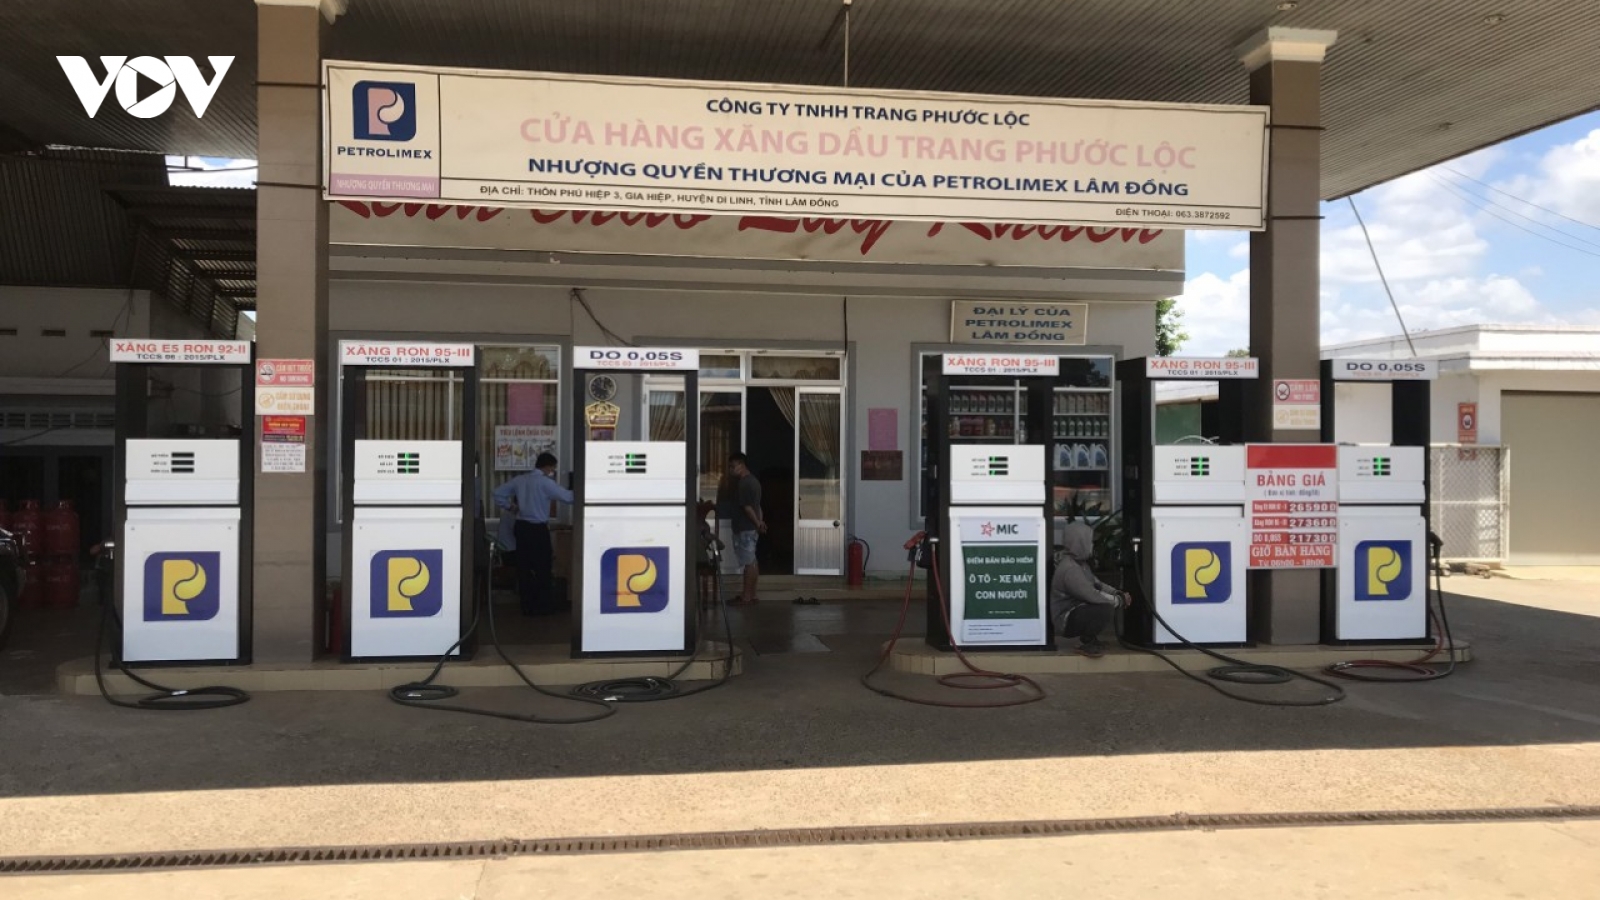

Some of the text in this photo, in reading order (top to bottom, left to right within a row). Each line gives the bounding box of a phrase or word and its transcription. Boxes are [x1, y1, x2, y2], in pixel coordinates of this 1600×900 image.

[706, 97, 1031, 129] CÔNG TY TNHH TRANG PHƯỚC LỘC
[519, 111, 1197, 174] CỬA HÀNG XĂNG DẦU TRANG PHƯỚC LỘC
[337, 145, 433, 160] PETROLIMEX
[528, 158, 1189, 196] NHƯỢNG QUYỀN THƯƠNG MẠI CỦA PETROLIMEX LÂM ĐỒNG
[480, 185, 499, 196] ĐỊA
[502, 185, 524, 196] CHỈ:
[527, 186, 557, 197] THÔN
[560, 186, 583, 198] PHÚ
[585, 189, 611, 200] HIỆP
[625, 191, 645, 201] GIA
[677, 193, 714, 205] HUYỆN
[716, 195, 727, 205] DI
[730, 196, 756, 206] LINH,
[758, 195, 782, 206] TỈNH
[785, 196, 807, 207] LÂM
[809, 196, 839, 208] ĐỒNG
[1115, 207, 1231, 220] ĐIỆN THOẠI: 063.3872592
[973, 305, 1071, 317] ĐẠI LÝ CỦA
[965, 319, 1073, 329] PETROLIMEX
[972, 329, 1065, 341] LÂM ĐỒNG
[115, 341, 246, 354] XĂNG E5 RON 92-II
[345, 344, 471, 357] XĂNG RON 95-III
[589, 350, 621, 360] DO
[947, 356, 1056, 367] XĂNG RON 95-III
[1150, 359, 1255, 371] XĂNG RON 95-III
[1346, 362, 1373, 371] DO
[1256, 470, 1326, 487] BẢNG GIÁ
[1289, 503, 1337, 512] 265900
[996, 523, 1019, 535] MIC
[1289, 519, 1337, 527] 273600
[1289, 534, 1337, 543] 217300
[969, 573, 976, 583] Ô
[977, 573, 991, 583] TÔ
[999, 574, 1011, 584] XE
[1013, 572, 1034, 584] MÁY
[975, 588, 1028, 600] CON NGƯỜI
